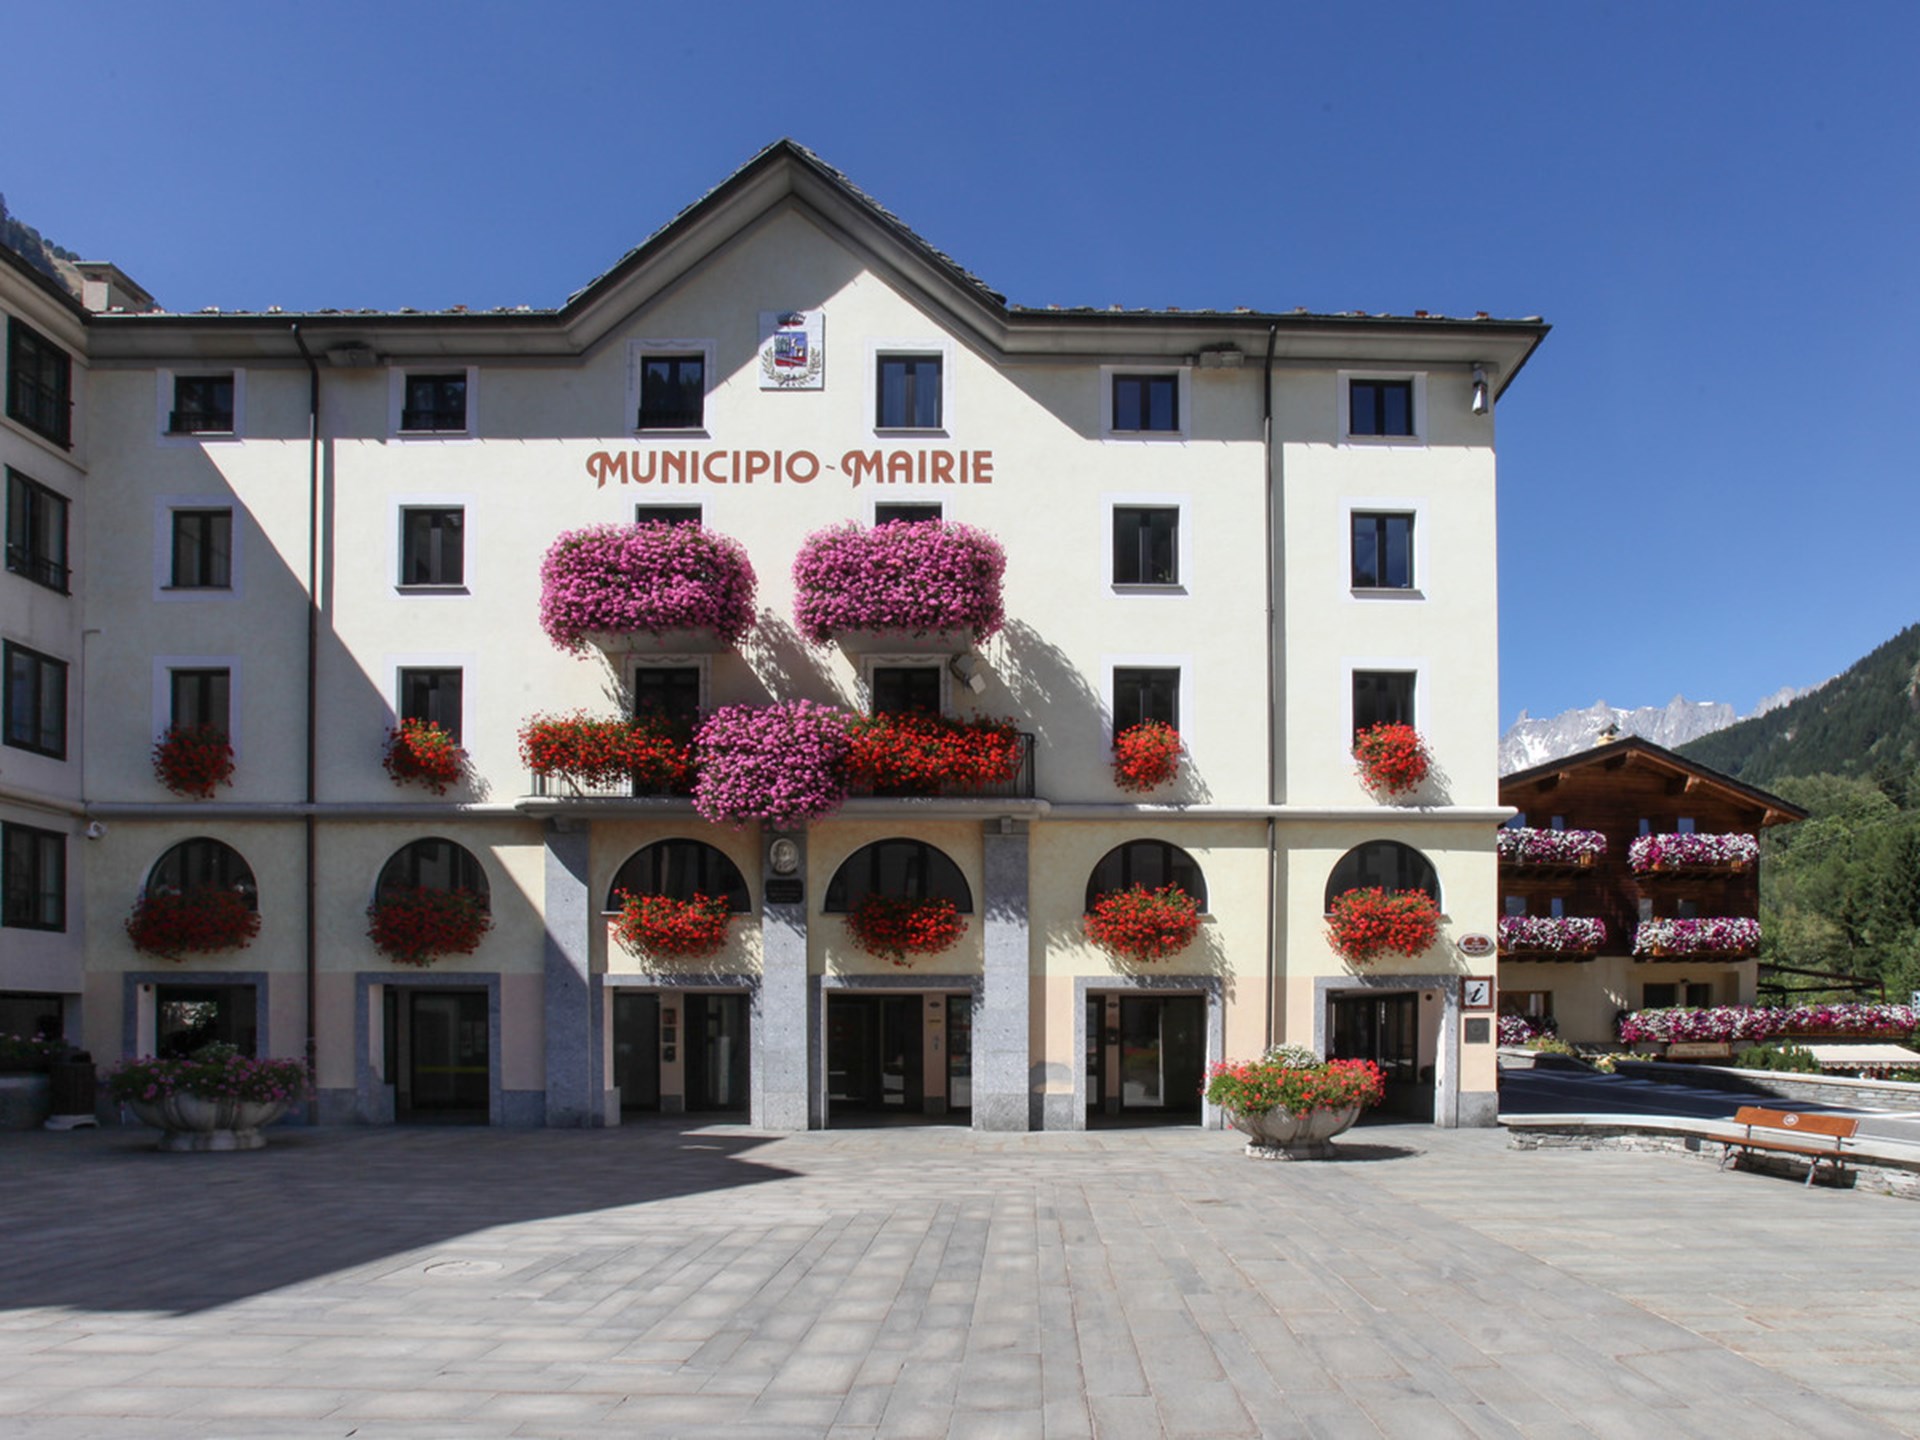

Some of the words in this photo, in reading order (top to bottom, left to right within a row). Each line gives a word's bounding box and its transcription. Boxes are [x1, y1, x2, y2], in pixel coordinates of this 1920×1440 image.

[586, 450, 820, 488] MUNICIPIO
[841, 450, 994, 488] MAIRIE
[1470, 983, 1484, 1003] i
